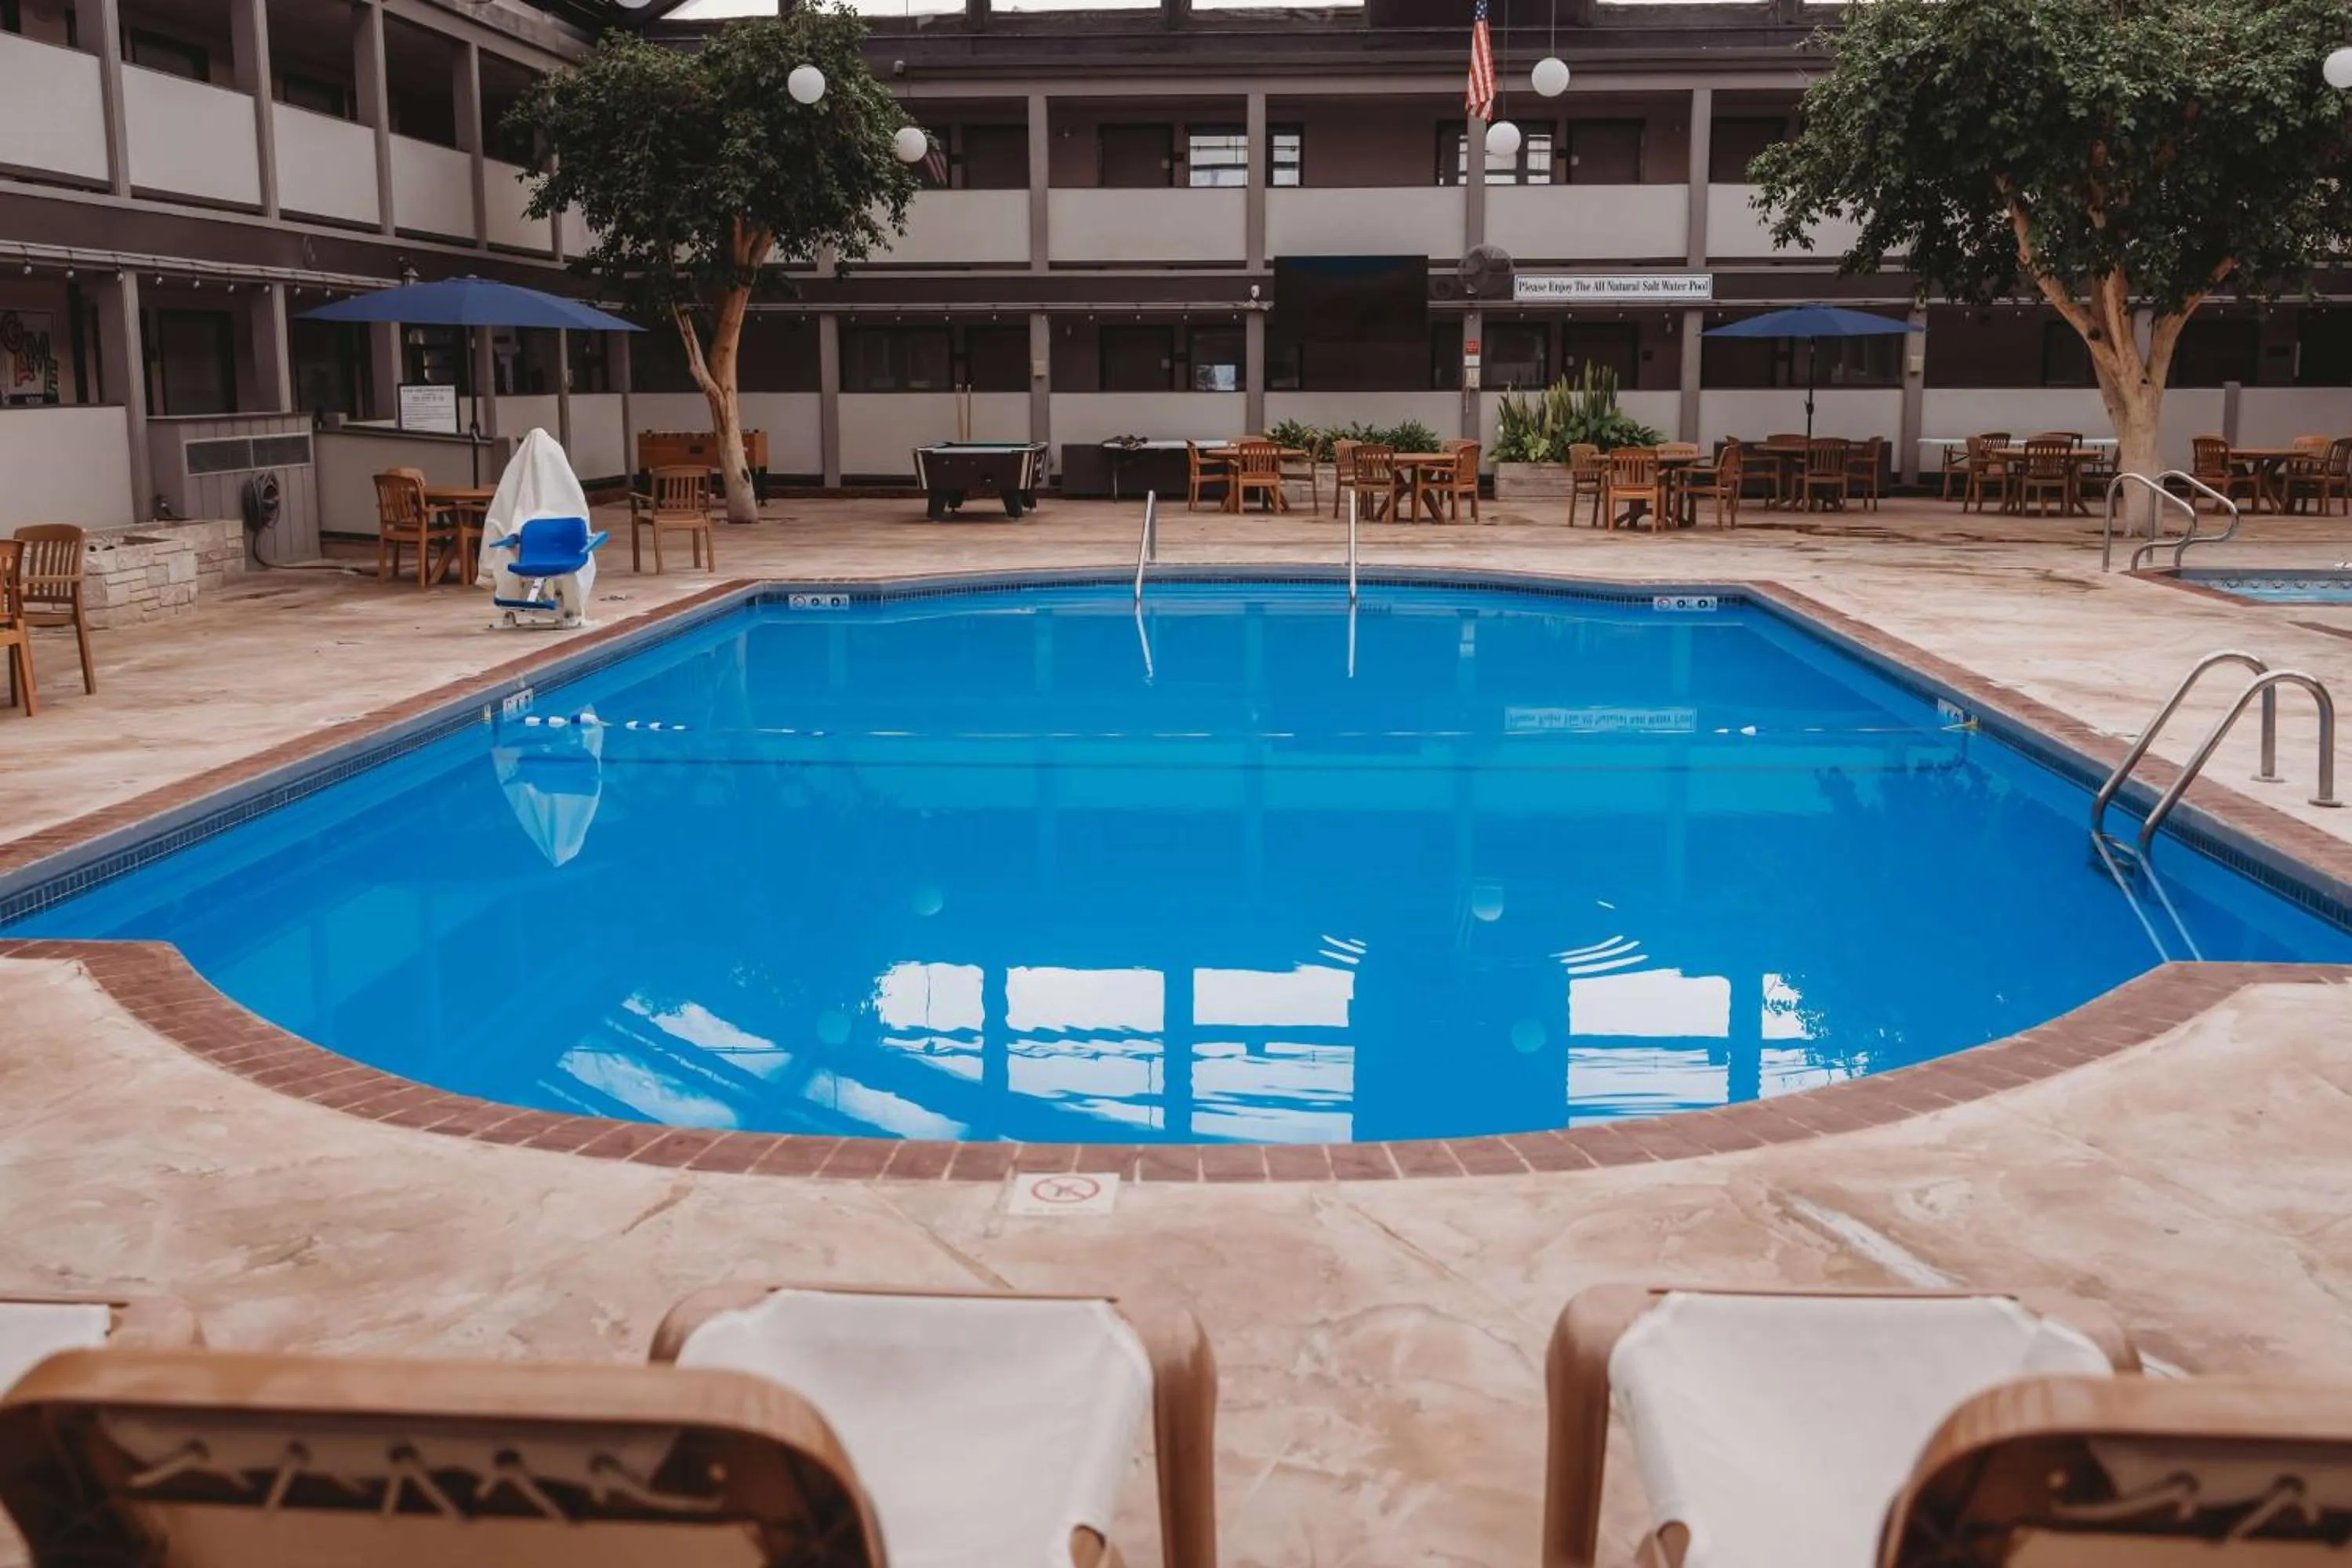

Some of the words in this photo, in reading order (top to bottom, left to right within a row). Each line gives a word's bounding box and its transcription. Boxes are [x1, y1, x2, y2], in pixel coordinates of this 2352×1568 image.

[1519, 281, 1547, 292] Please
[1548, 281, 1572, 293] Enjoy
[1574, 281, 1592, 292] The
[1593, 280, 1605, 292] All
[1607, 280, 1640, 291] Natural
[1642, 280, 1660, 291] Salt
[1661, 280, 1688, 291] Water
[1689, 280, 1708, 291] Pool
